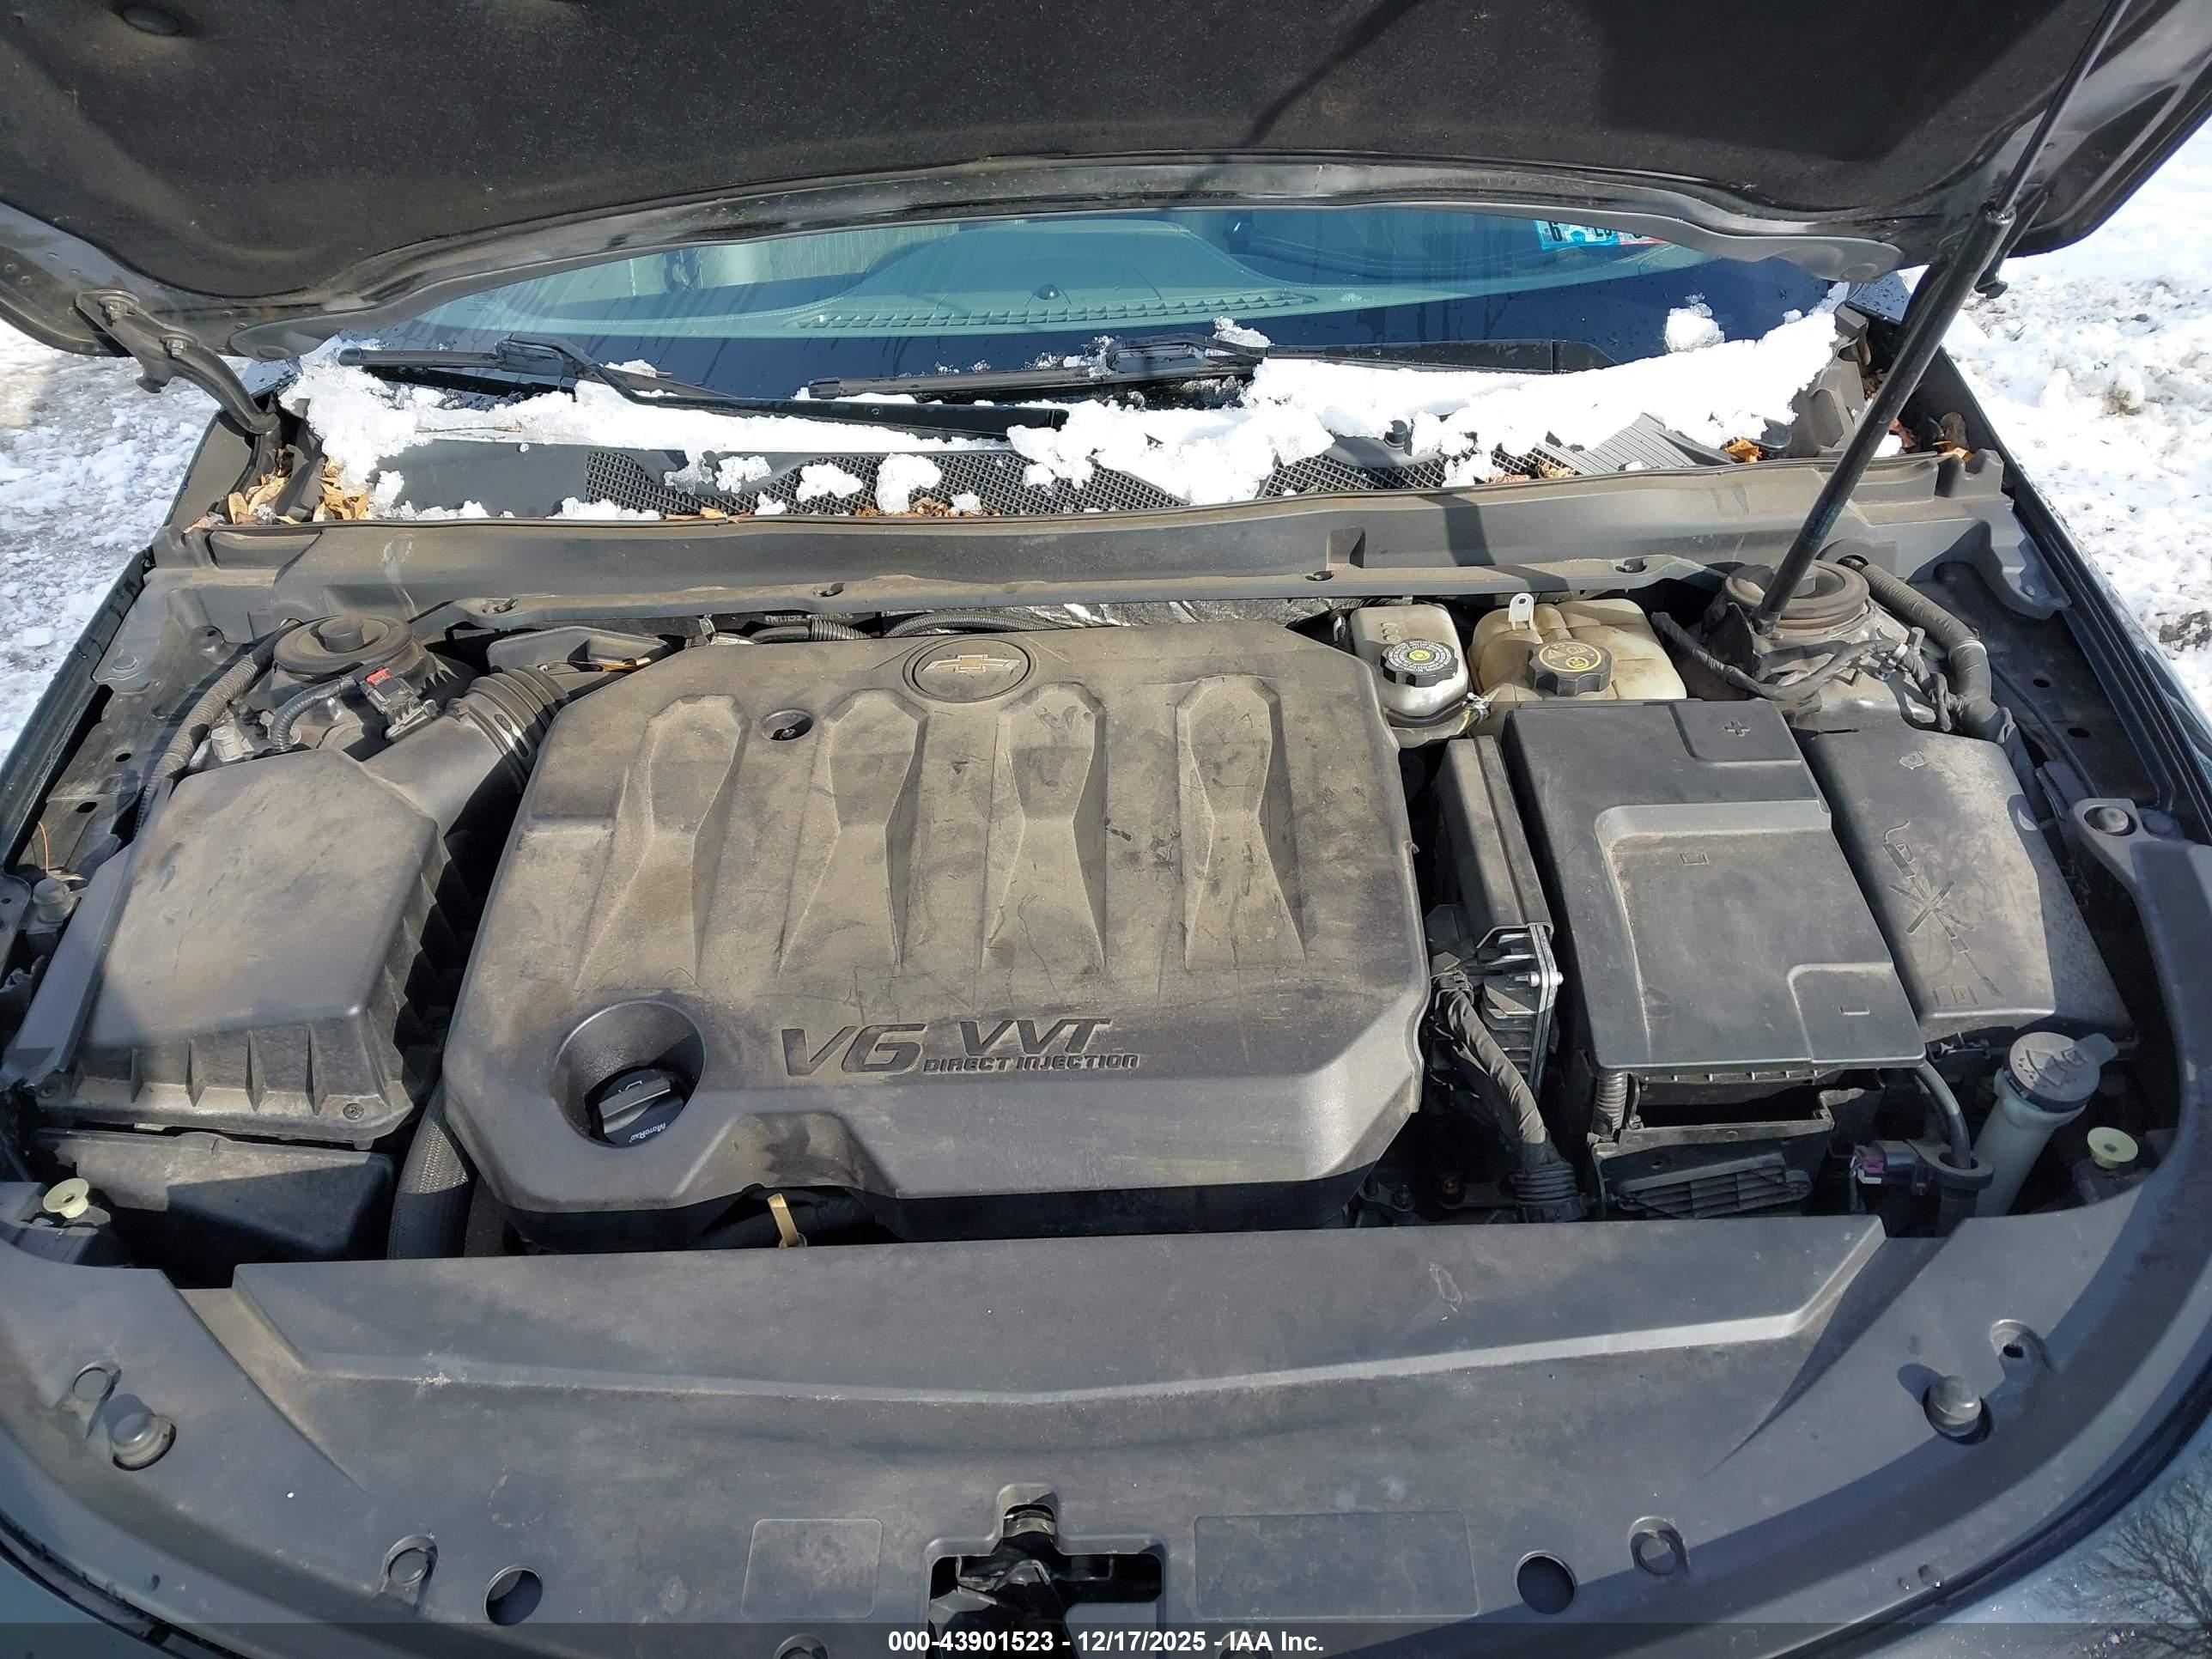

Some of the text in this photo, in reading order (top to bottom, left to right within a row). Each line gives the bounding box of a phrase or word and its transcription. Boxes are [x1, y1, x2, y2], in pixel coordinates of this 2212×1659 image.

[781, 1018, 1113, 1077] V6 VVT
[923, 1053, 1139, 1073] DIRECT INJECTION
